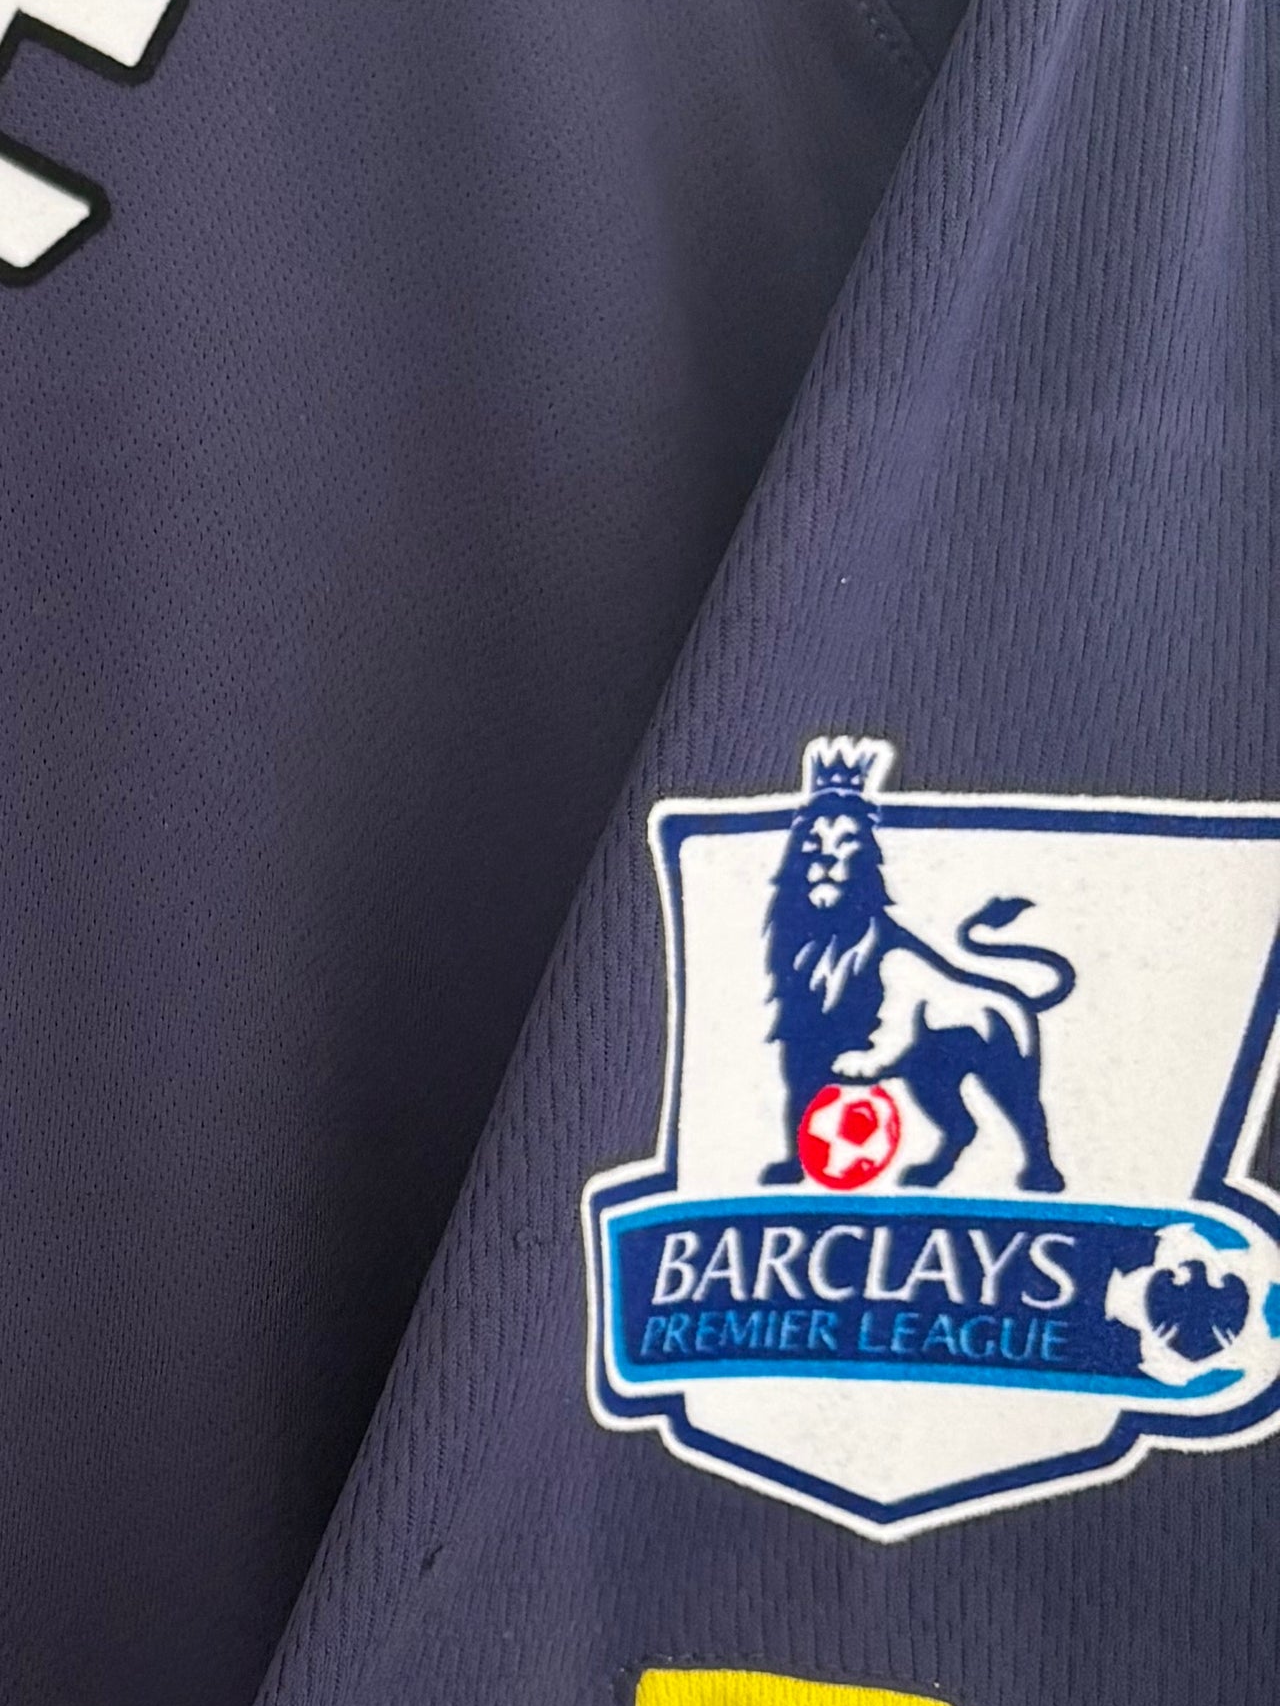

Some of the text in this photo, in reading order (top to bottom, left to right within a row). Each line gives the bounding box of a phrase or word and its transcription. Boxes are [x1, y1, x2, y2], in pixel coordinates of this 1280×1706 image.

[651, 1224, 1077, 1311] BARCLAYS
[640, 1308, 1070, 1363] PREMIER LEAGUE
